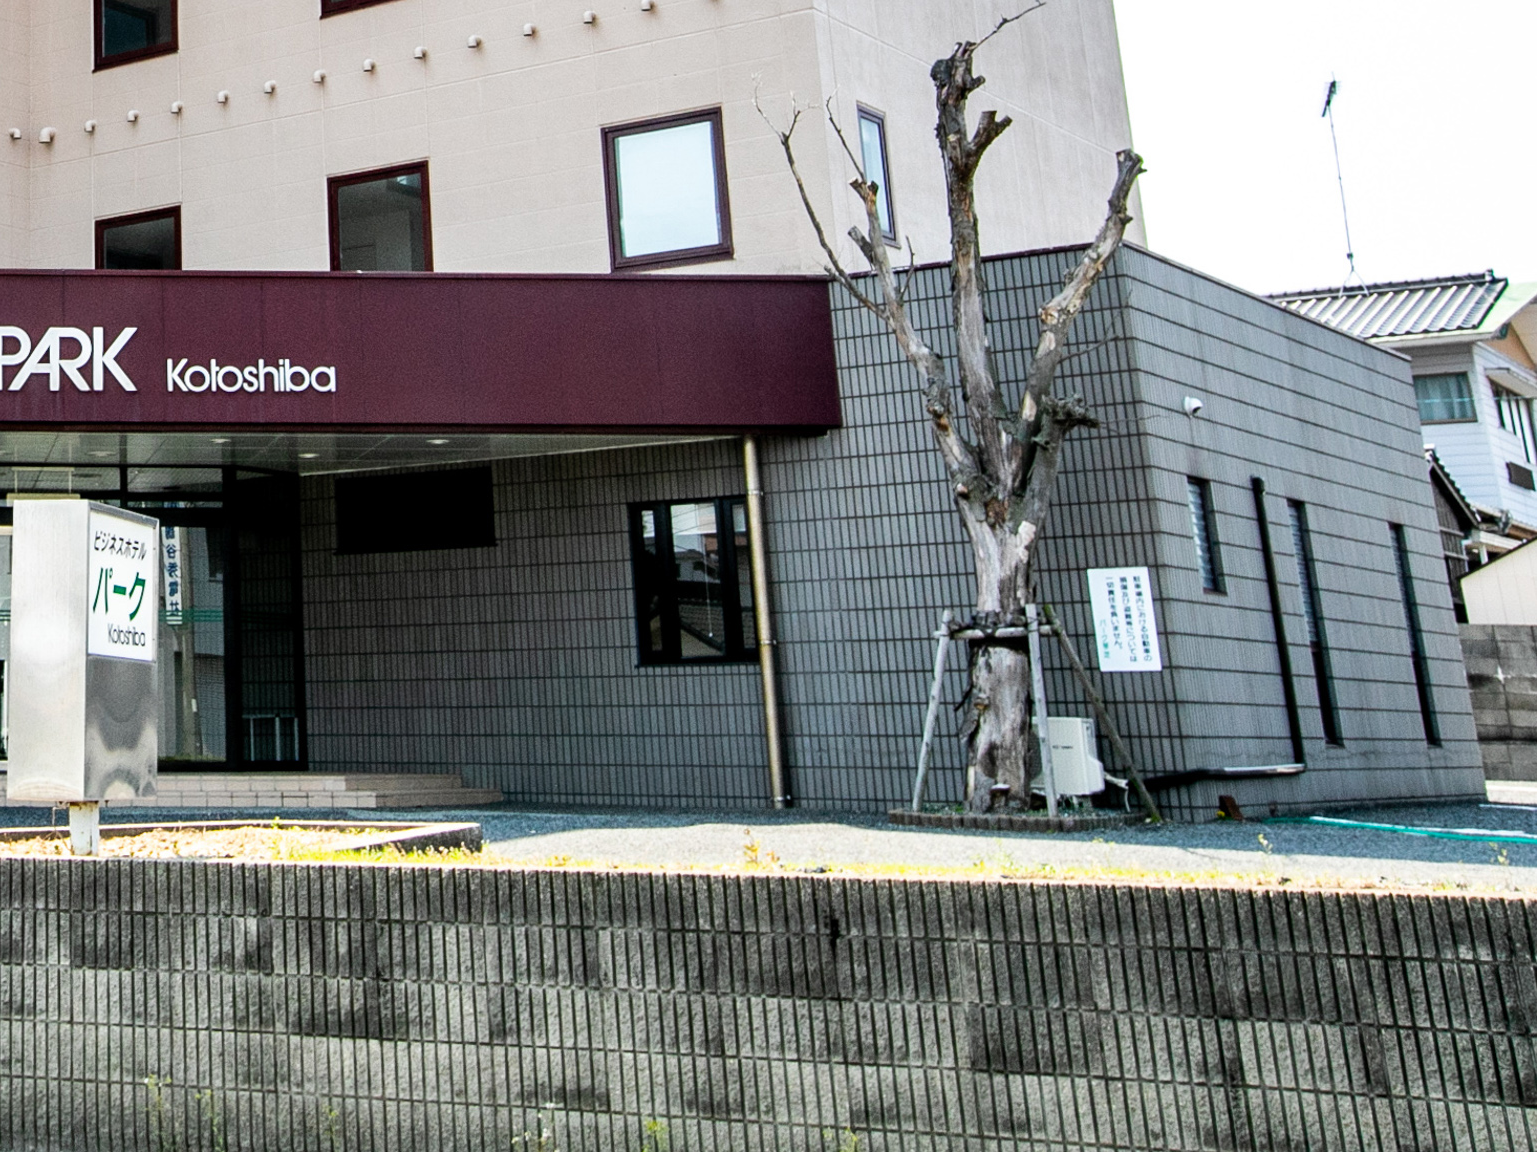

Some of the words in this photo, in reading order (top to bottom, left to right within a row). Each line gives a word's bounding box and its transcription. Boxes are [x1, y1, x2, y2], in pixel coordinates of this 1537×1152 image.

[166, 357, 337, 393] Kotoshiba
[93, 530, 147, 561] ビジネスホテル
[92, 567, 146, 622] パーク
[107, 623, 146, 647] Kotoshiba
